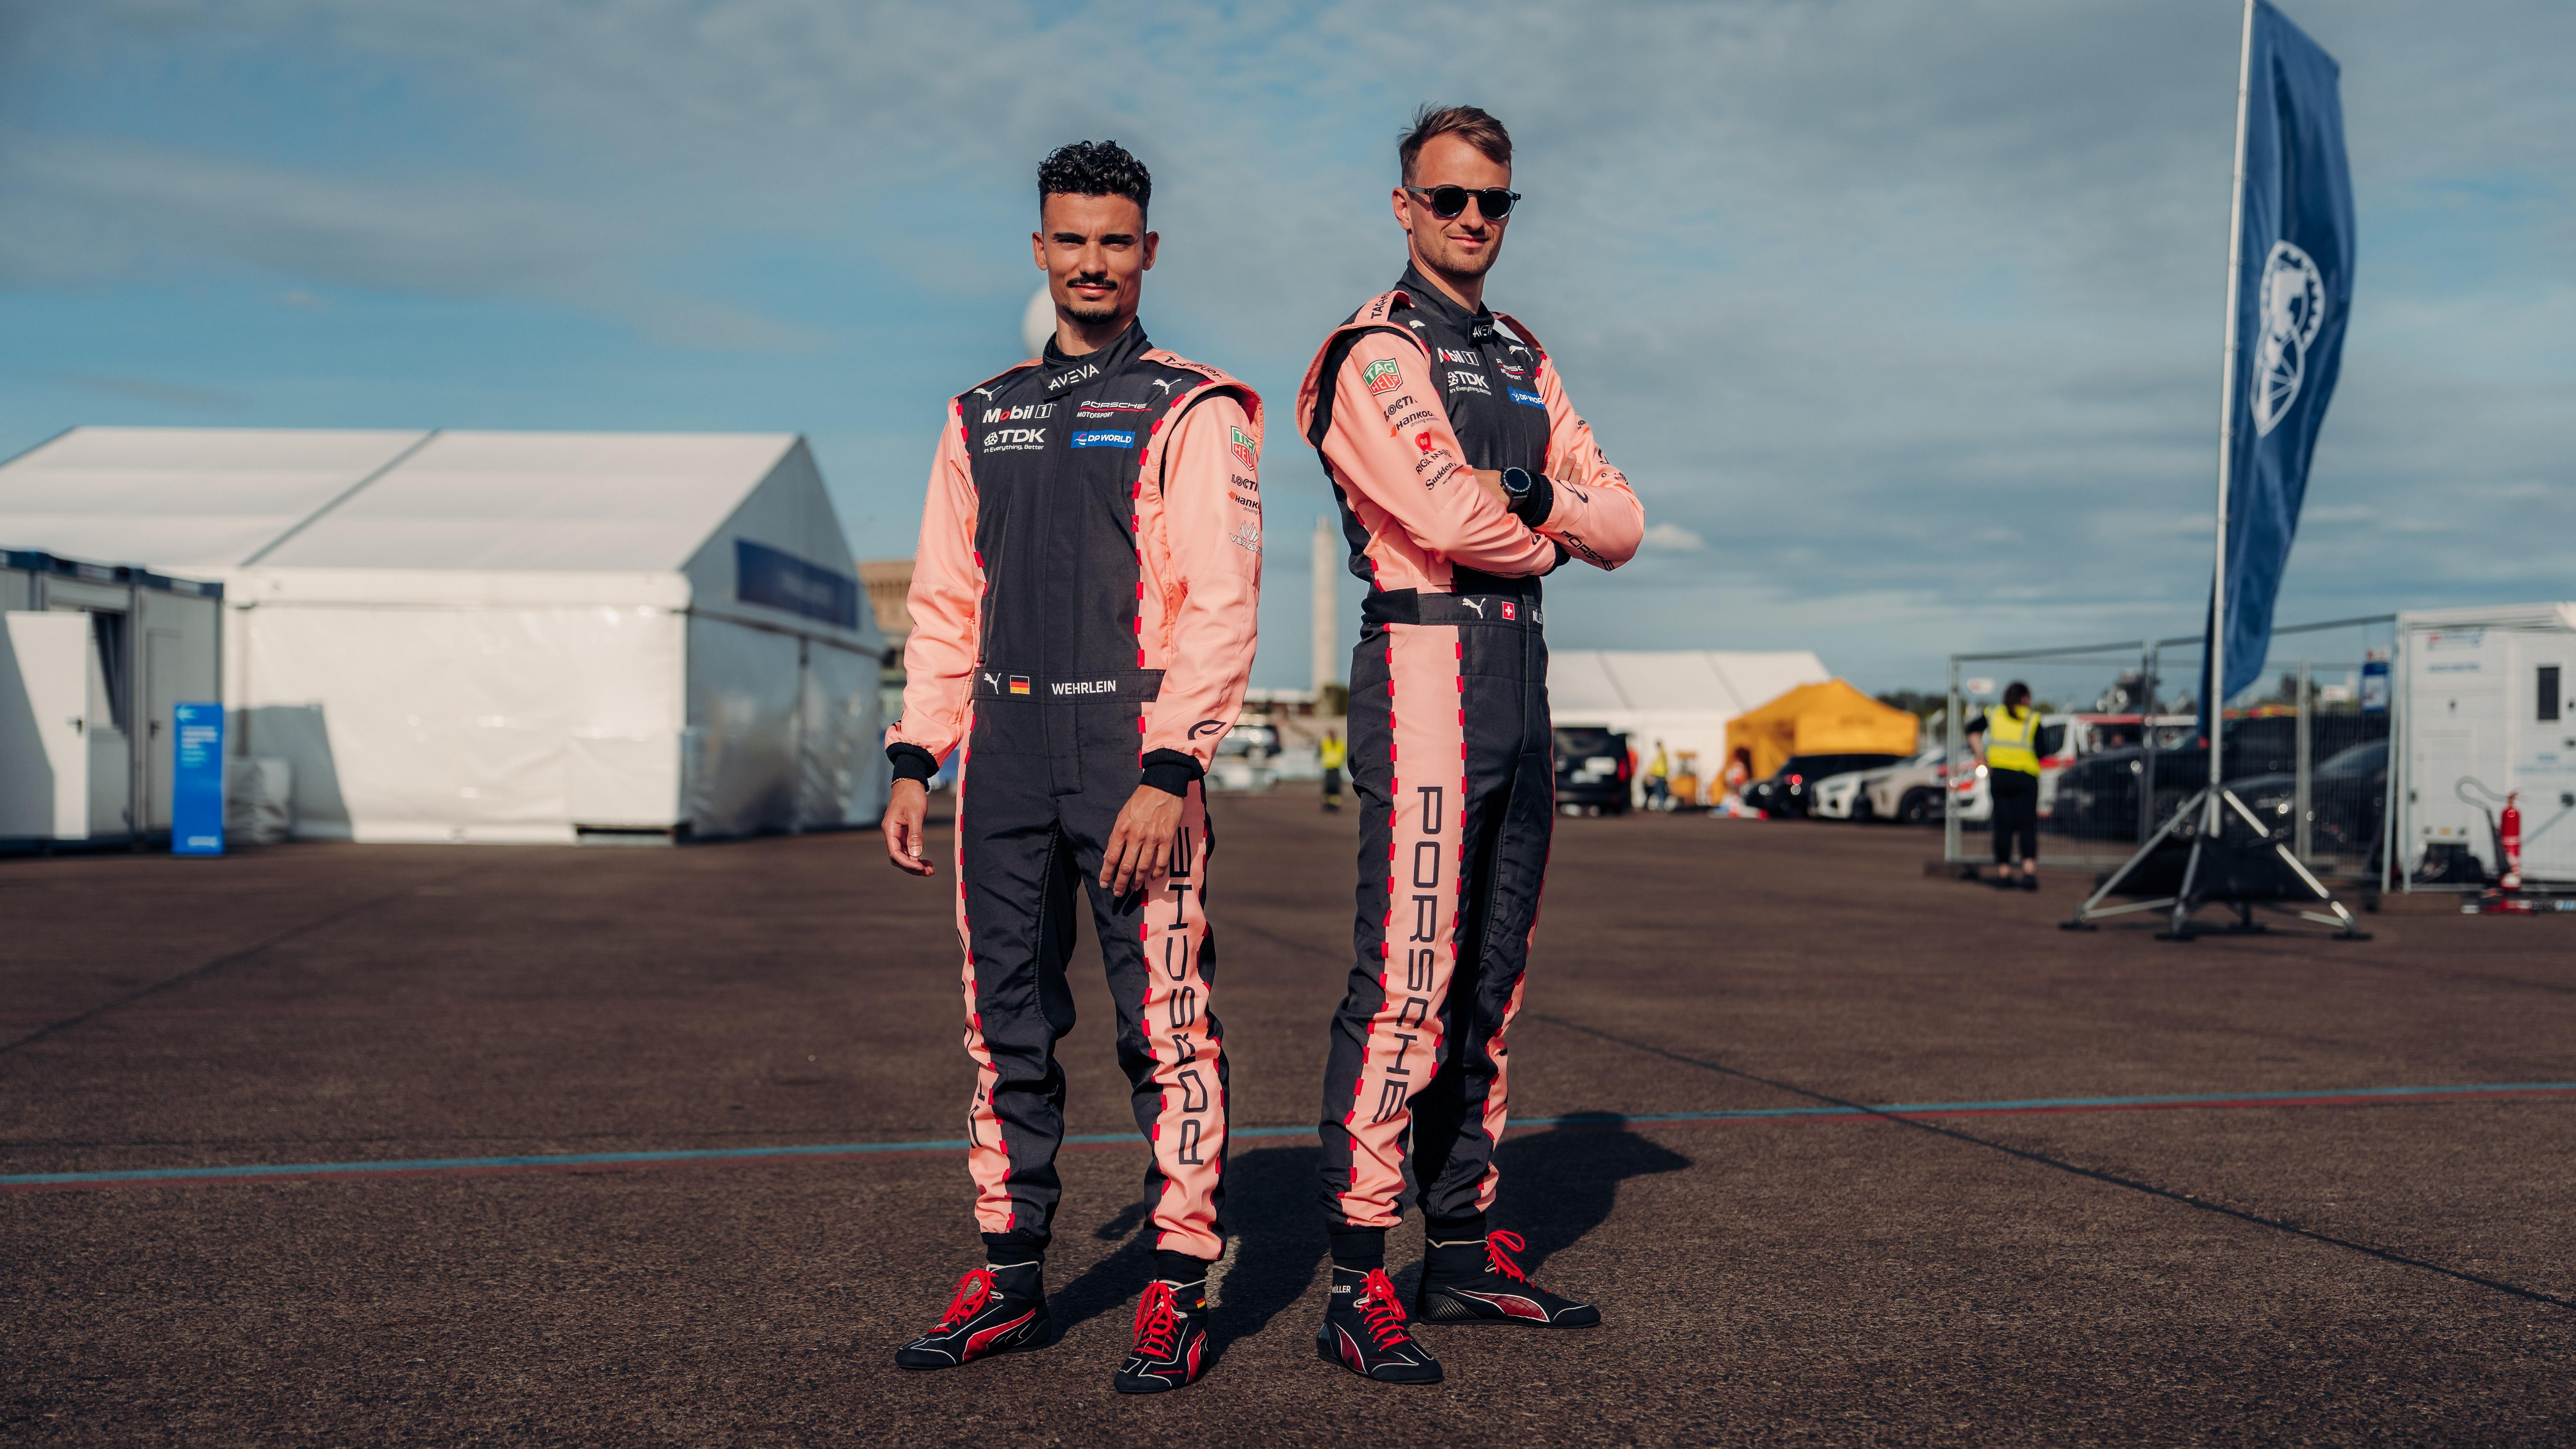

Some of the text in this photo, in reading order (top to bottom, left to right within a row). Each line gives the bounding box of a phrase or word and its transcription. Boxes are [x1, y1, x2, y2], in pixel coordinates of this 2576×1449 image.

[1048, 364, 1100, 391] AVEVA
[1366, 363, 1394, 380] TAG
[1454, 371, 1489, 389] TDK
[1081, 401, 1147, 409] PORSCHE
[1528, 395, 1544, 404] WOR
[982, 405, 1034, 423] Mobil
[1383, 395, 1418, 423] LOCTI
[1410, 418, 1426, 427] driving
[998, 428, 1047, 443] TDK
[1101, 434, 1132, 443] WORLD
[990, 444, 1023, 452] Everything,
[1416, 458, 1433, 475] RIGA
[1231, 474, 1258, 492] LOCTI
[1235, 495, 1260, 510] Hank
[1243, 507, 1258, 515] driving
[1051, 680, 1116, 695] WEHRLEIN
[1372, 786, 1443, 1123] PORSCHE
[1165, 827, 1208, 1165] PORSCHE
[1332, 1285, 1351, 1293] MÜLLER
